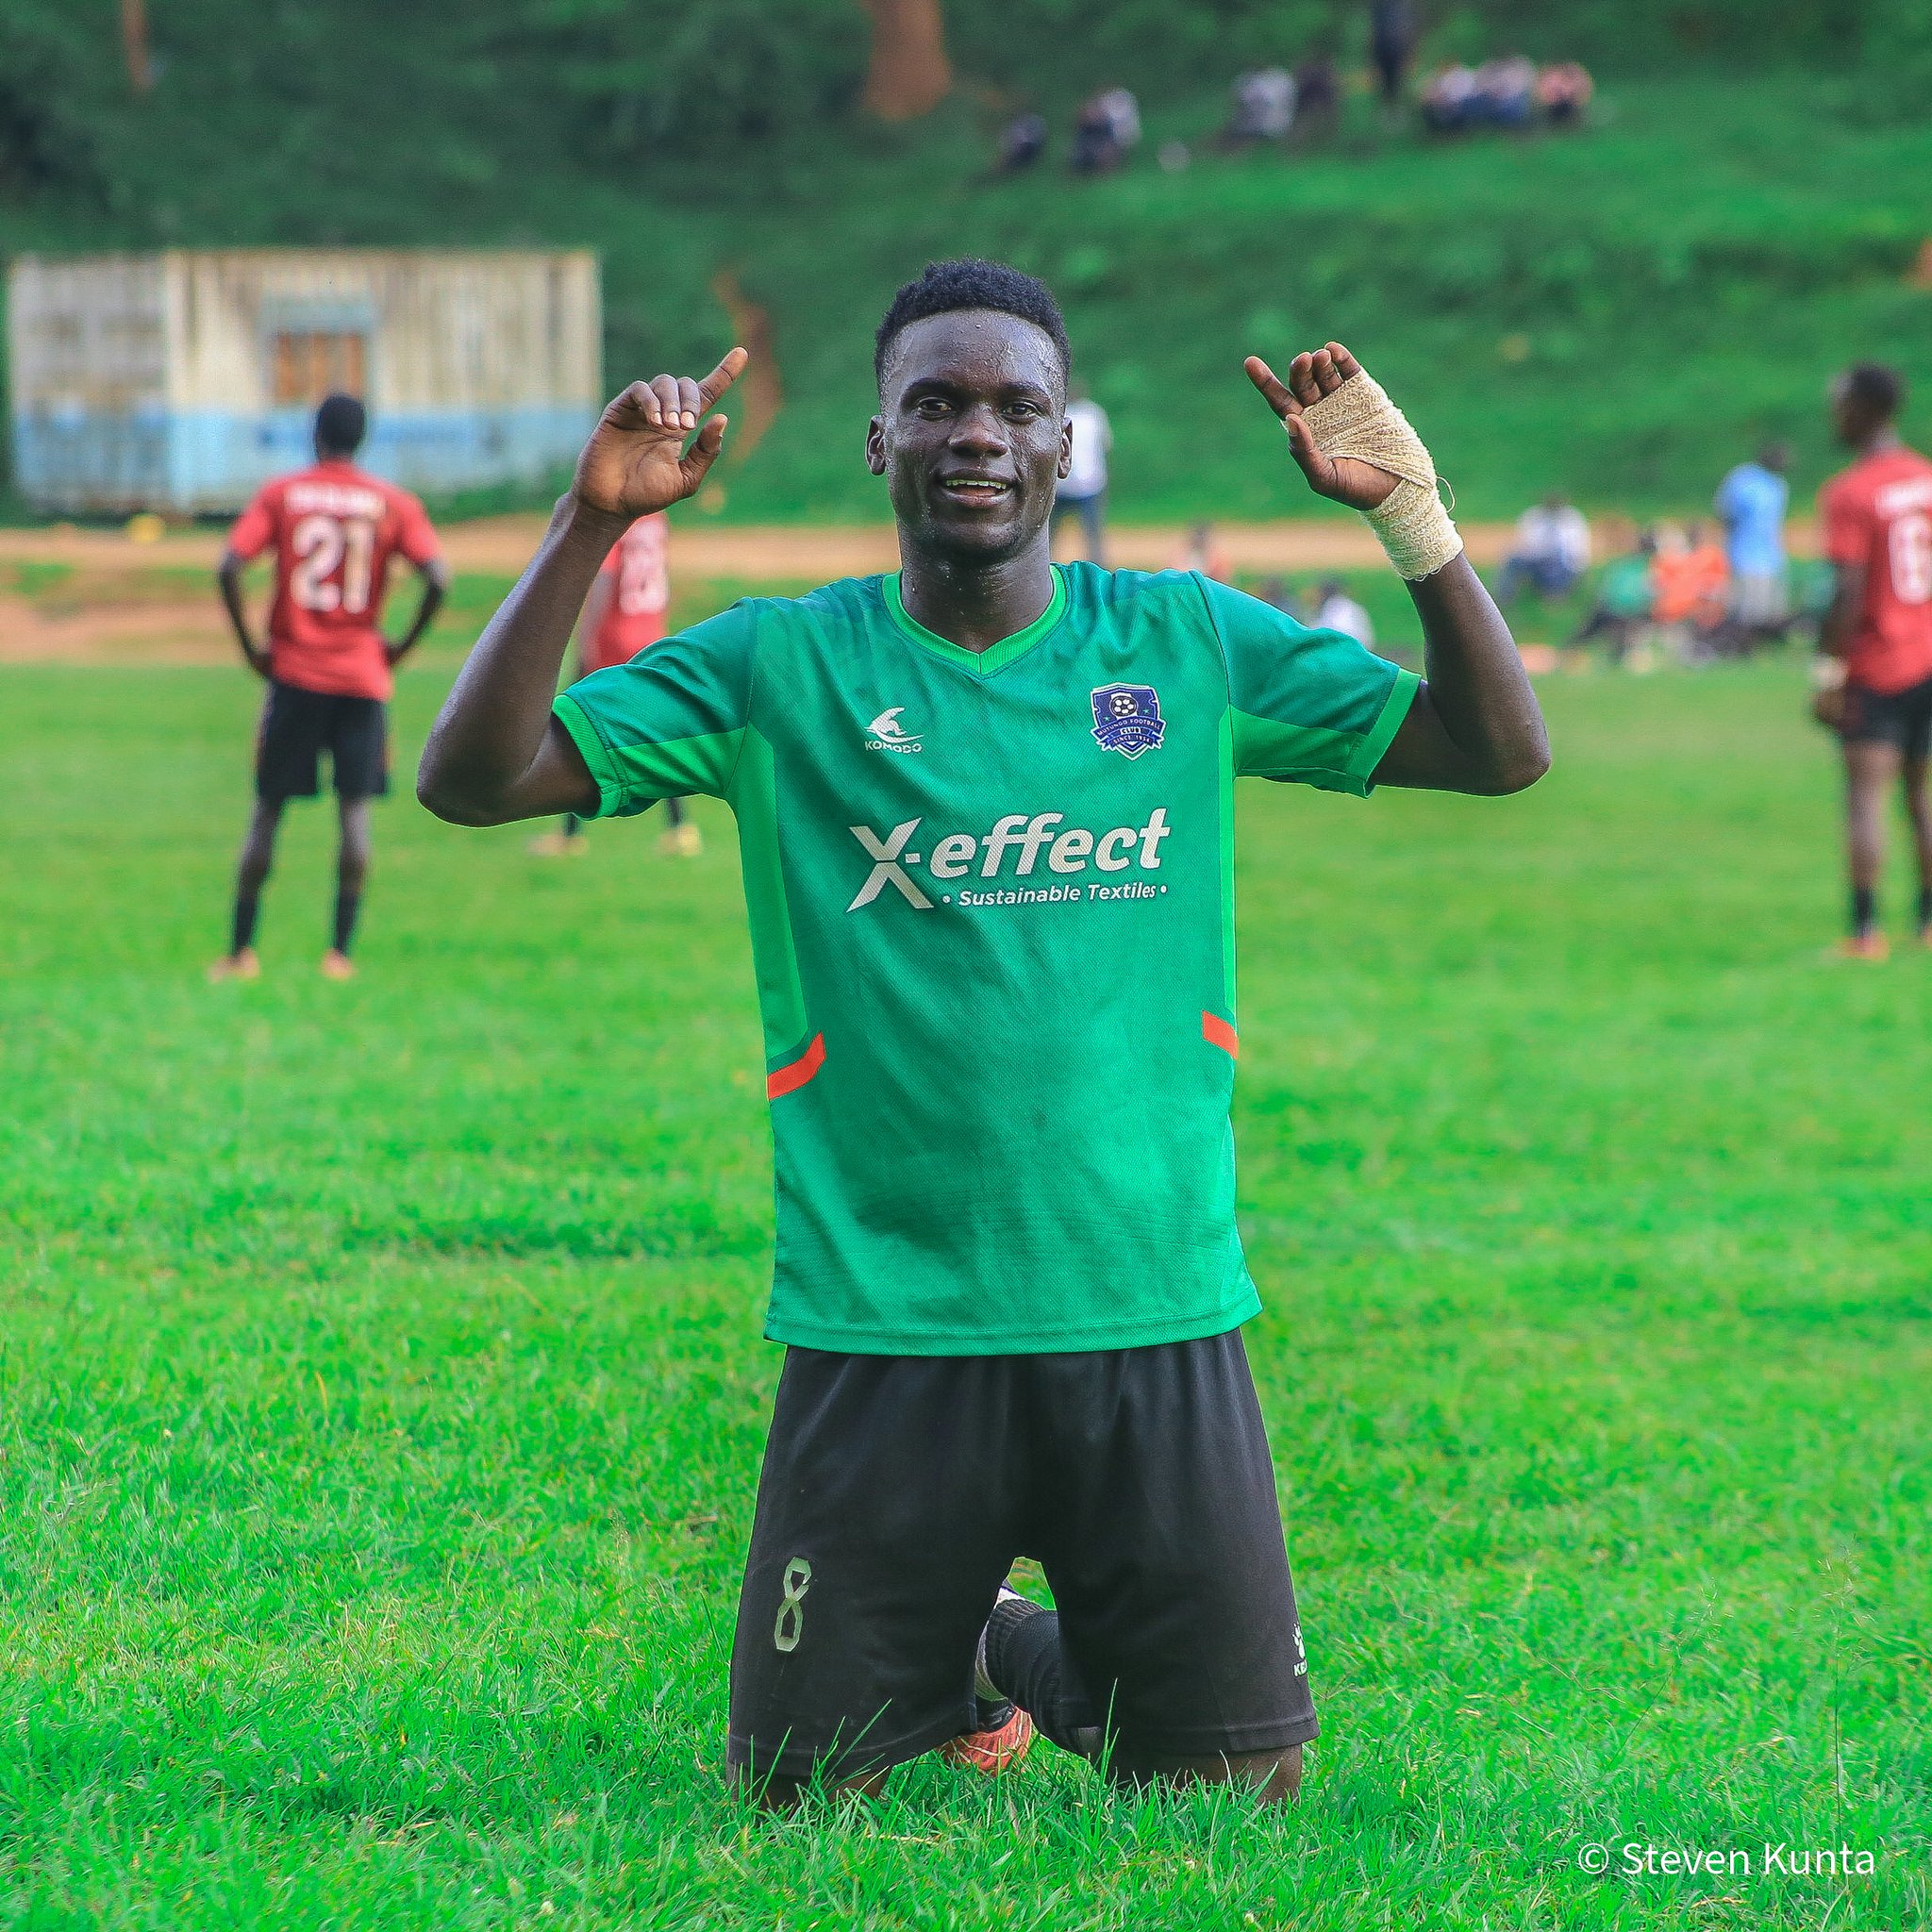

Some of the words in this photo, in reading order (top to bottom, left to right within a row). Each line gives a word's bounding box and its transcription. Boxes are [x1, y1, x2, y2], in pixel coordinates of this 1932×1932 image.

[291, 515, 375, 613] 21
[846, 808, 1171, 912] X-effect
[958, 884, 1081, 906] Sustainable
[1088, 881, 1157, 901] Textiles
[774, 1557, 811, 1652] 8
